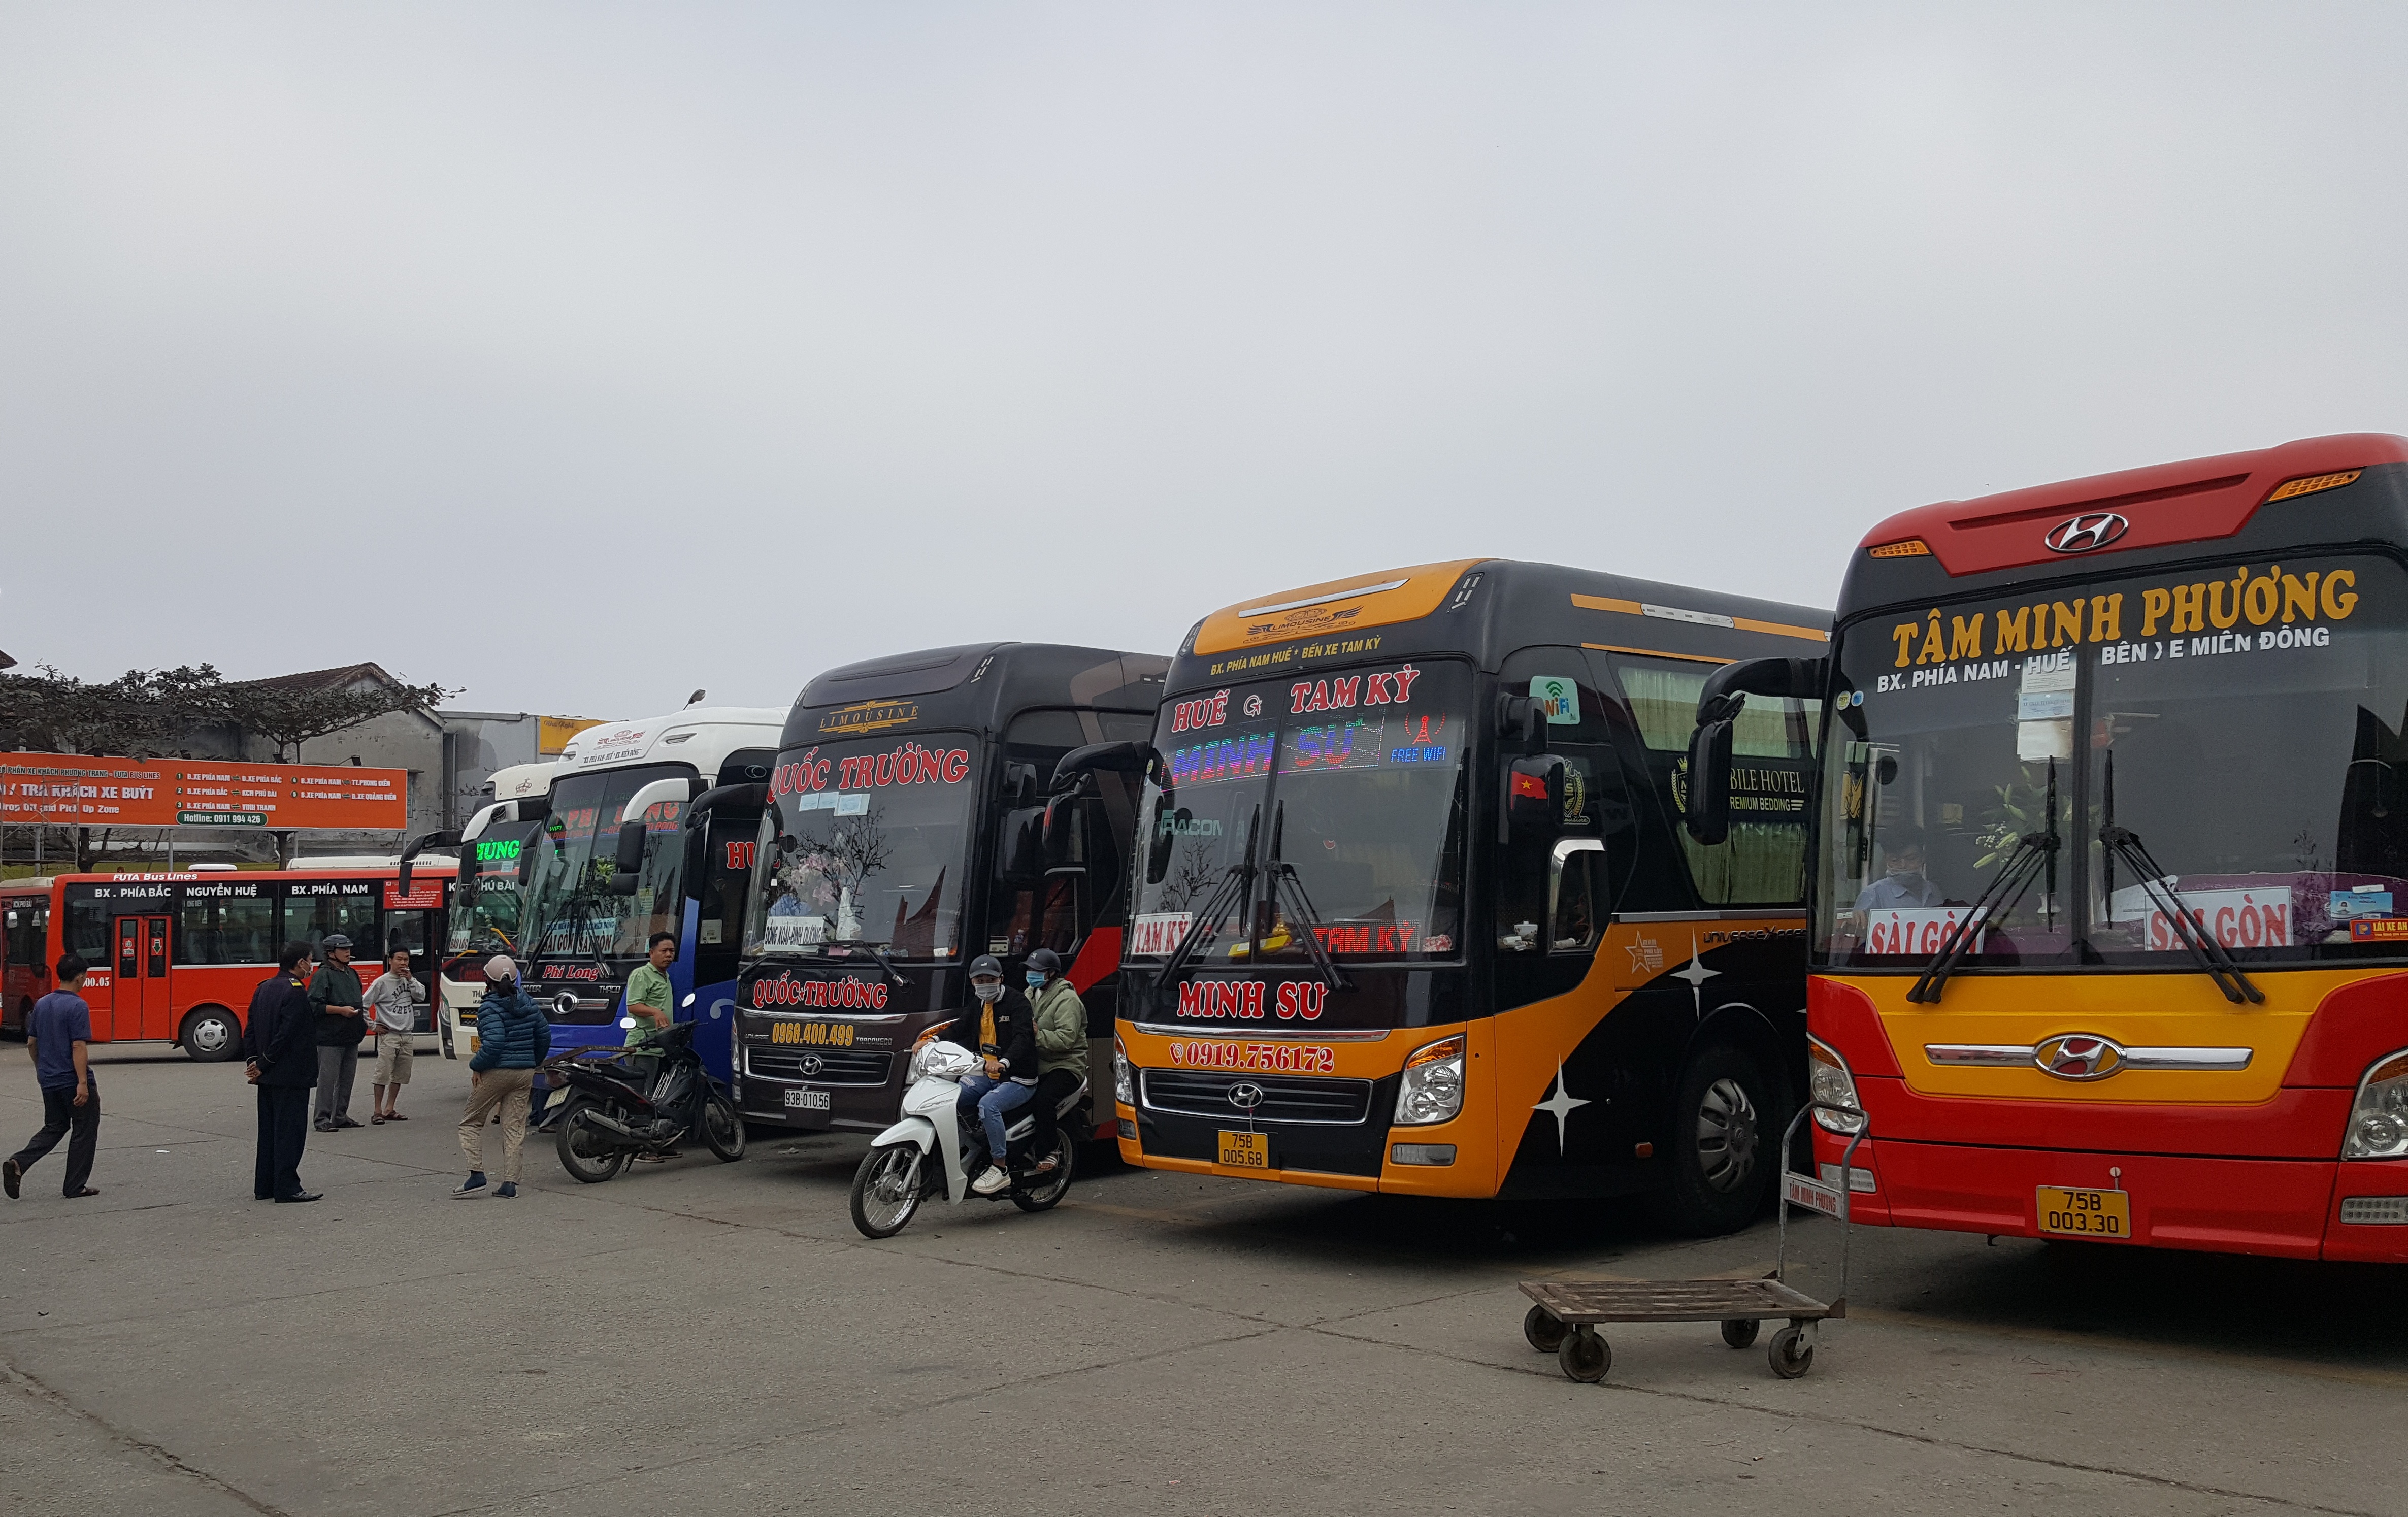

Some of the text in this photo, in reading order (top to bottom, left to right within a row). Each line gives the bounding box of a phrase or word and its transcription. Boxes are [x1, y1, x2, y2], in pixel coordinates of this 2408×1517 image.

[1272, 616, 1331, 630] LIMOUSINE
[1892, 565, 2358, 668] TÂM MINH PHƯƠNG
[1226, 655, 1247, 672] PHÍA
[1249, 654, 1270, 668] NAM
[1271, 645, 1295, 663] HUẾ
[1301, 642, 1323, 659] BẾN
[1324, 642, 1339, 656] XE
[1341, 639, 1364, 653] TAM
[1365, 635, 1382, 650] KỲ
[1911, 662, 1958, 687] PHÍA
[1963, 661, 2009, 682] NAM
[2027, 645, 2074, 675] HUẾ
[2259, 624, 2330, 650] ĐÔNG
[1290, 664, 1420, 714] TAM KỲ
[819, 705, 919, 729] LIMOUSINE
[1171, 689, 1230, 733] HUẾ
[1171, 731, 1275, 785] MINH
[1391, 746, 1446, 763] FREE WIFI
[27, 767, 37, 775] XE
[88, 770, 108, 778] TRANG
[143, 772, 161, 780] LINES
[767, 742, 969, 804] QUỐC TRƯỜNG
[1760, 770, 1805, 793] HOTEL
[51, 782, 97, 799] KHÁCH
[101, 786, 118, 799] XE
[122, 785, 154, 800] BUÝT
[83, 804, 94, 813] Up
[97, 805, 120, 813] Zone
[1759, 797, 1791, 811] BEDDING
[184, 813, 261, 823] Hotline: 0911 994 426
[113, 873, 140, 881] FUTA
[143, 873, 165, 881] Bus
[120, 885, 147, 898] PHÍA
[148, 884, 172, 897] BẮC
[186, 883, 232, 897] NGUYỄN
[235, 884, 257, 898] HUỆ
[342, 884, 368, 894] NAM
[497, 880, 515, 891] BÀI
[2215, 894, 2287, 948] GÒN
[2373, 921, 2396, 931] LÁI XE
[1135, 921, 1164, 953] TAM
[1313, 926, 1370, 953] TAM
[1869, 912, 1916, 954] SÀI
[543, 965, 600, 982] Phi Long
[753, 969, 888, 1009] QUỐC TRƯỜNG
[1176, 981, 1330, 1020] MINH SƯ
[772, 1023, 854, 1046] 0968.400.499
[1186, 1042, 1335, 1073] 0919.756172
[1232, 1134, 1253, 1149] 75B
[1223, 1149, 1263, 1166] 005.68
[2063, 1191, 2101, 1211] 75B
[2049, 1211, 2119, 1233] 003.30
